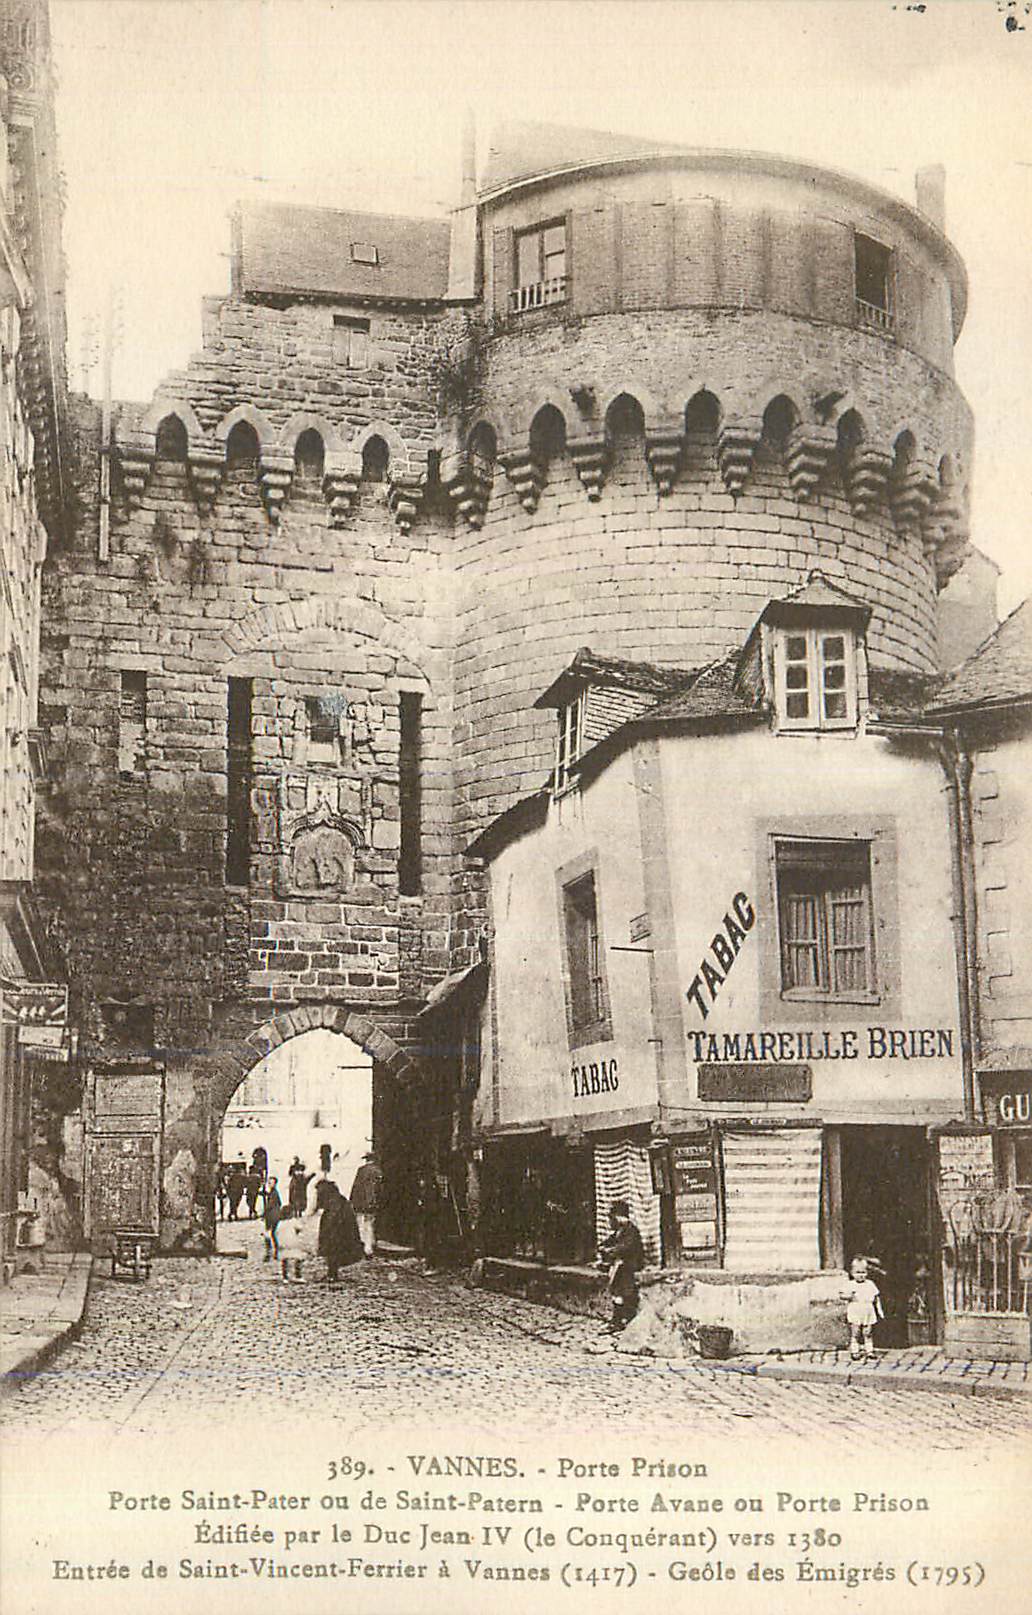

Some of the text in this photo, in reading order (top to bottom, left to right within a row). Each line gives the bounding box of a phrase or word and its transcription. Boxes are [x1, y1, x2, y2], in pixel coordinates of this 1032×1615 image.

[686, 891, 756, 1020] TABAC
[687, 1027, 954, 1062] TAMAREILLE BRIEN
[571, 1058, 619, 1097] TABAC
[999, 1093, 1031, 1121] GU
